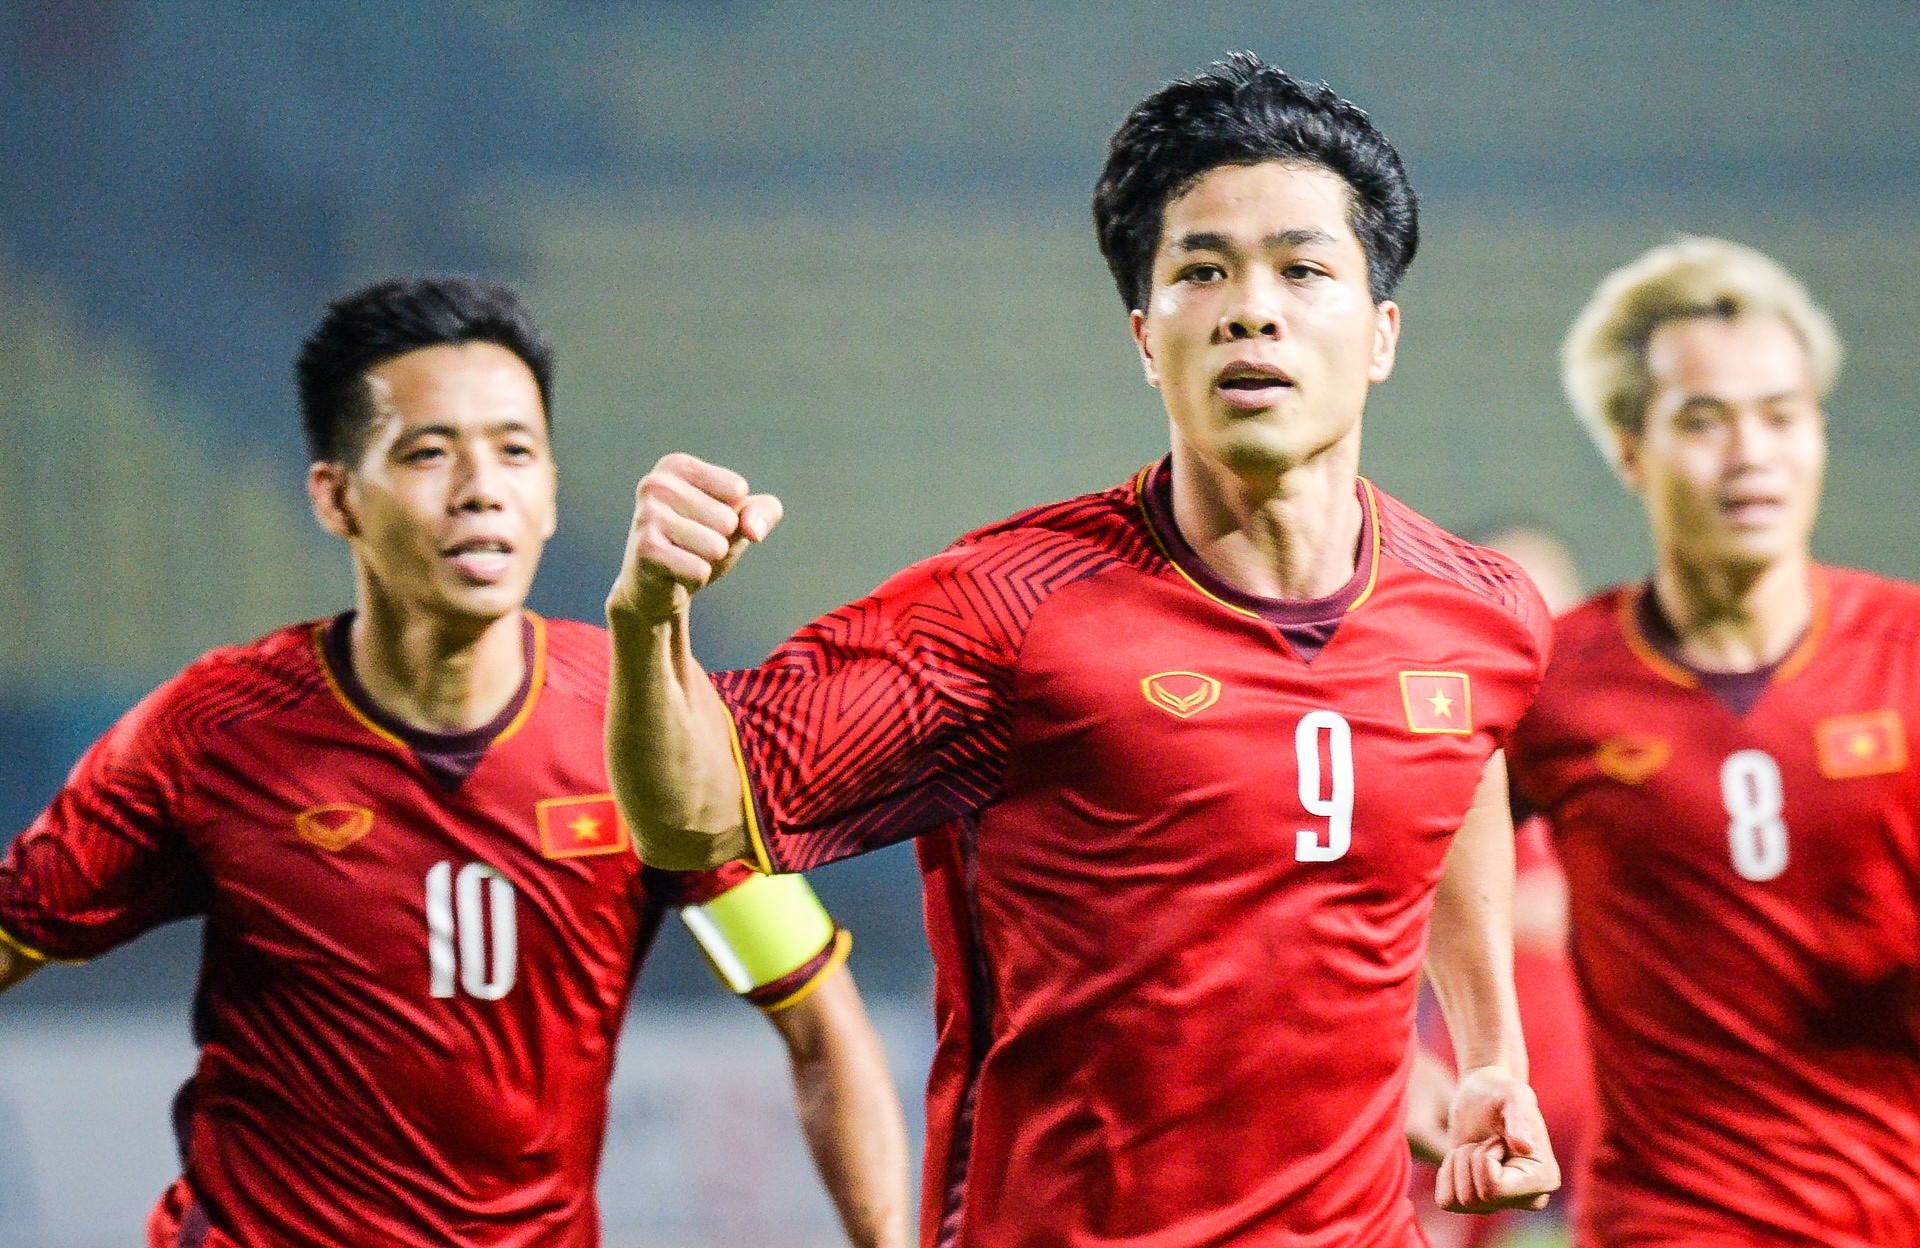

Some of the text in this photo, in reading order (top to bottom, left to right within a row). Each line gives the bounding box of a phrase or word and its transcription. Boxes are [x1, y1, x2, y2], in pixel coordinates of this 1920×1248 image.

[1294, 708, 1355, 863] 9
[1719, 749, 1789, 882] 8
[425, 861, 518, 1001] 10
